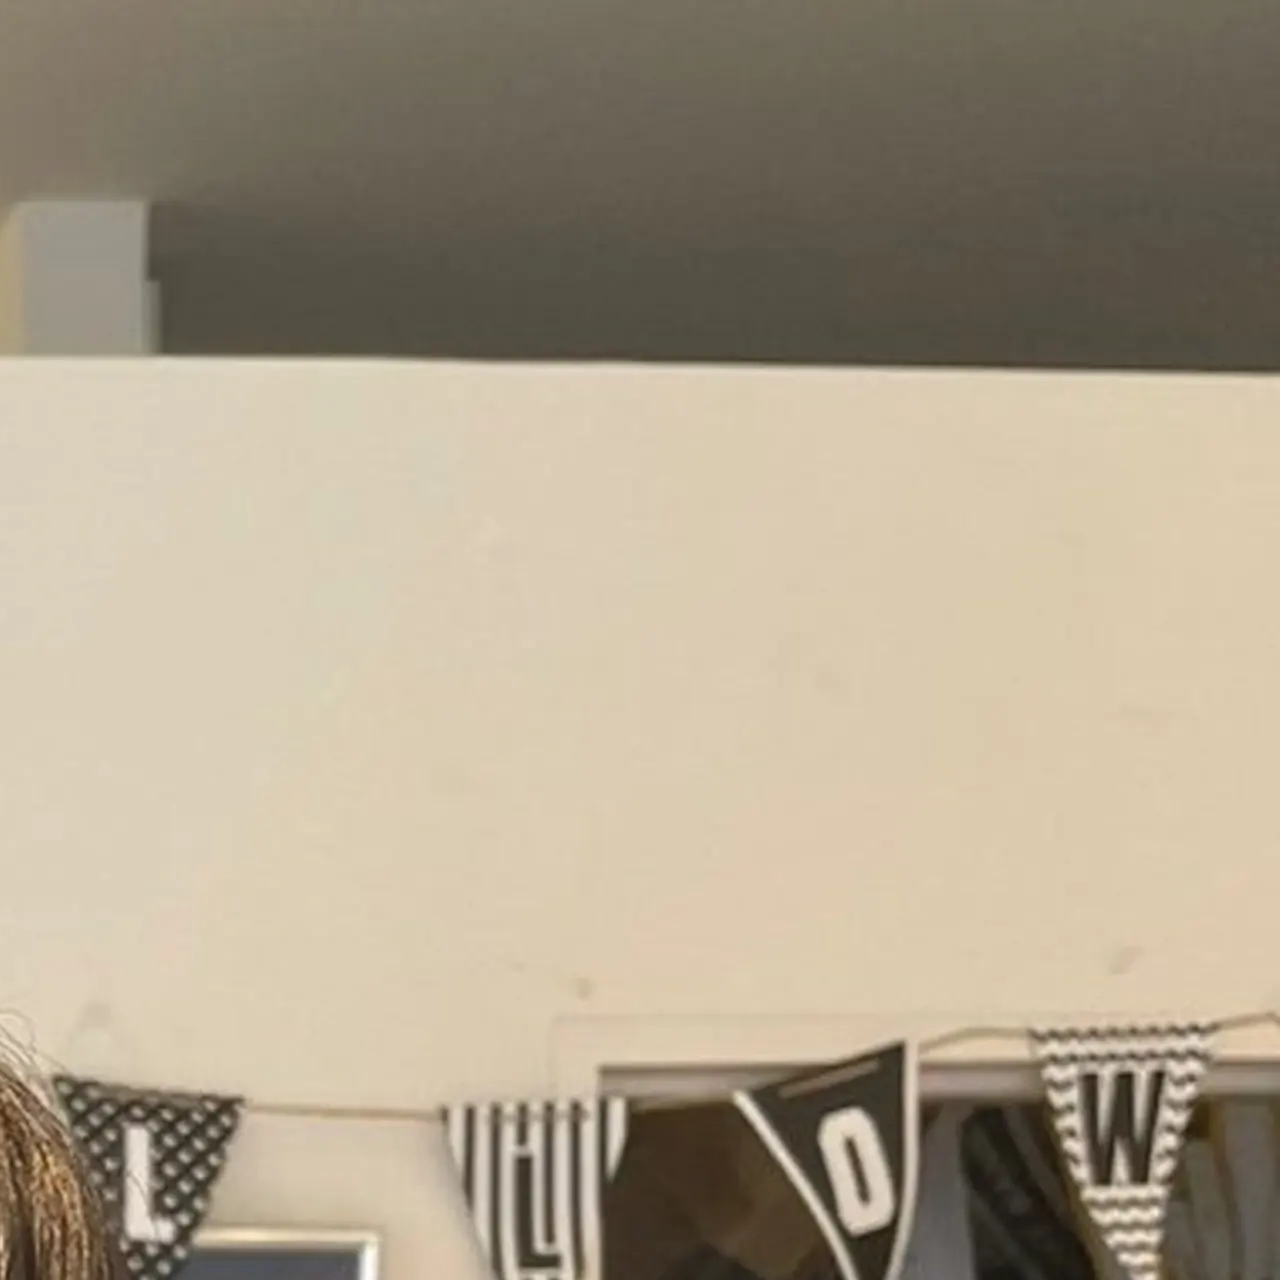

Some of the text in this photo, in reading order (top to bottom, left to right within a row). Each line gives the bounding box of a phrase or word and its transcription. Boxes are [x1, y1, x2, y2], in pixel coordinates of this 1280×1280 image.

[124, 1121, 177, 1242] L
[514, 1153, 562, 1270] L
[1081, 1070, 1167, 1185] W
